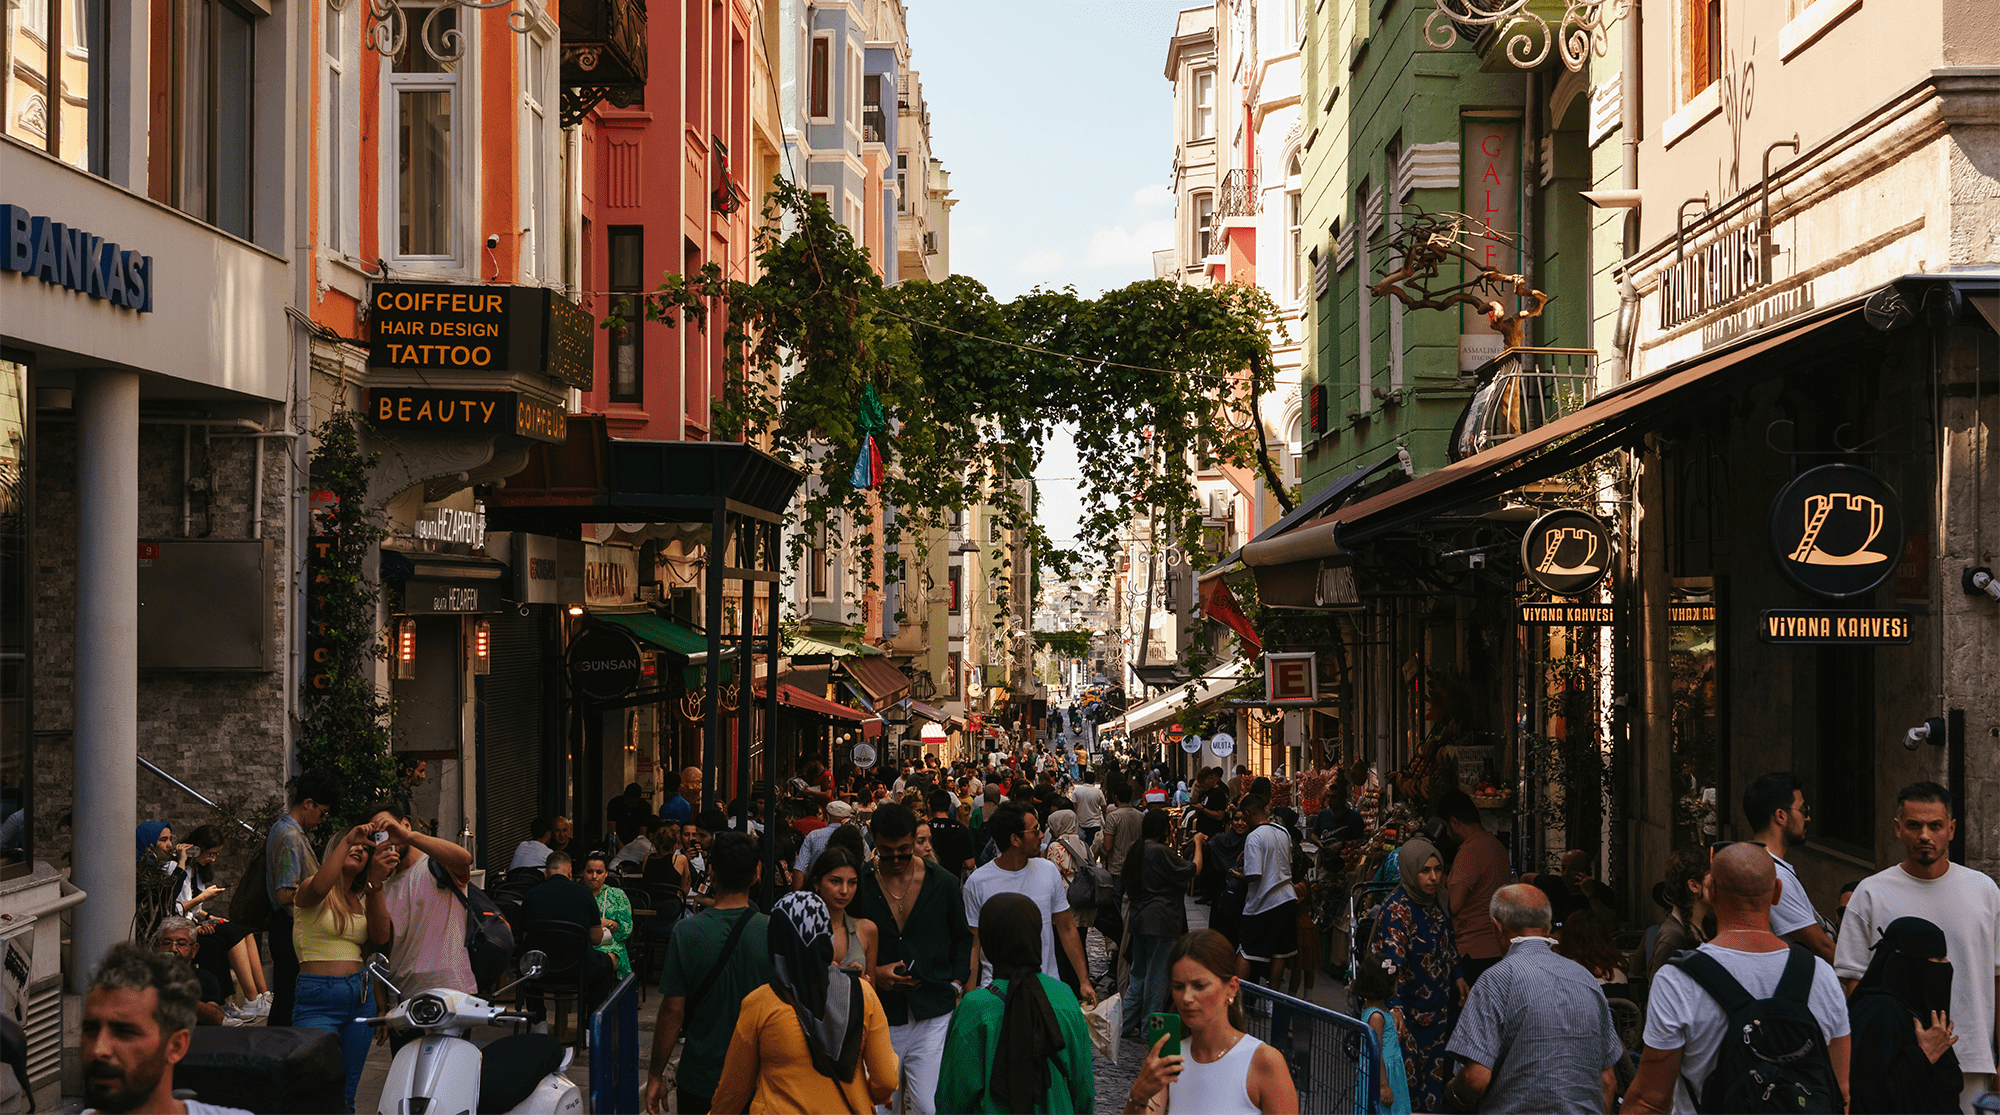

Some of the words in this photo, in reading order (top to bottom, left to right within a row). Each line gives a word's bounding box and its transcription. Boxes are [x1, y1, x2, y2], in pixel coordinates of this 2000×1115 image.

[377, 292, 503, 313] COIFFEUR
[381, 321, 425, 335] HAIR
[430, 322, 499, 337] DESIGN
[387, 344, 491, 366] TATTOO
[379, 397, 496, 424] BEAUTY
[518, 401, 565, 440] COIFFEUR
[438, 508, 476, 544] HEZARFEN
[448, 588, 478, 611] HEZARFEN
[582, 659, 637, 671] GÜNSAN
[1279, 664, 1305, 695] E
